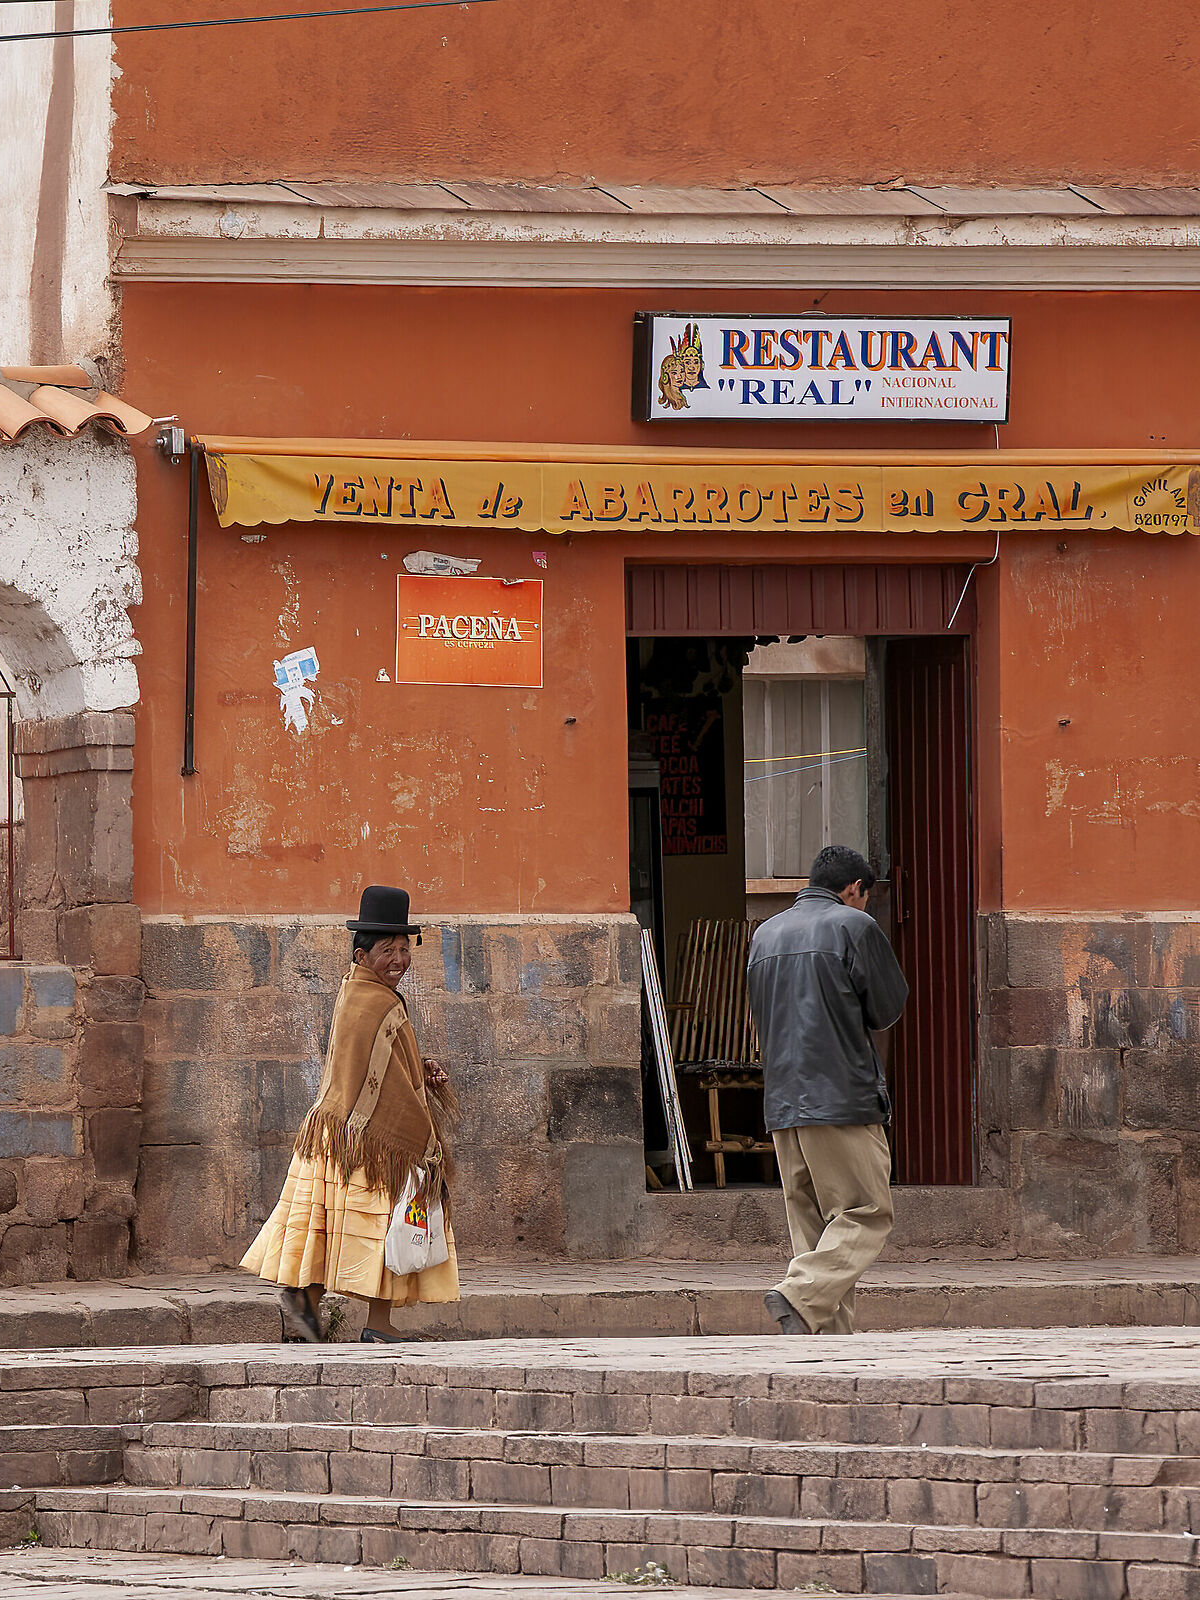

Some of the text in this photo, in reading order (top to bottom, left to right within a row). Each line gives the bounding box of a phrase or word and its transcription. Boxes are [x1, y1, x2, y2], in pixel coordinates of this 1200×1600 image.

[719, 329, 1009, 372] RESTAURANT
[718, 378, 872, 406] "REAL"
[881, 376, 957, 389] NACIONAL
[880, 396, 999, 409] INTERNACIONAL
[309, 474, 456, 520] VENTA
[476, 482, 524, 519] de
[559, 478, 865, 523] ABARROTES
[886, 488, 934, 517] en
[1133, 478, 1187, 509] GAVILAN
[1134, 513, 1189, 527] 820797
[418, 609, 523, 641] PACEÑA
[444, 640, 496, 650] es cerveza
[660, 755, 700, 775] OCOA
[661, 776, 702, 796] ATES
[661, 797, 705, 817] ALCHI
